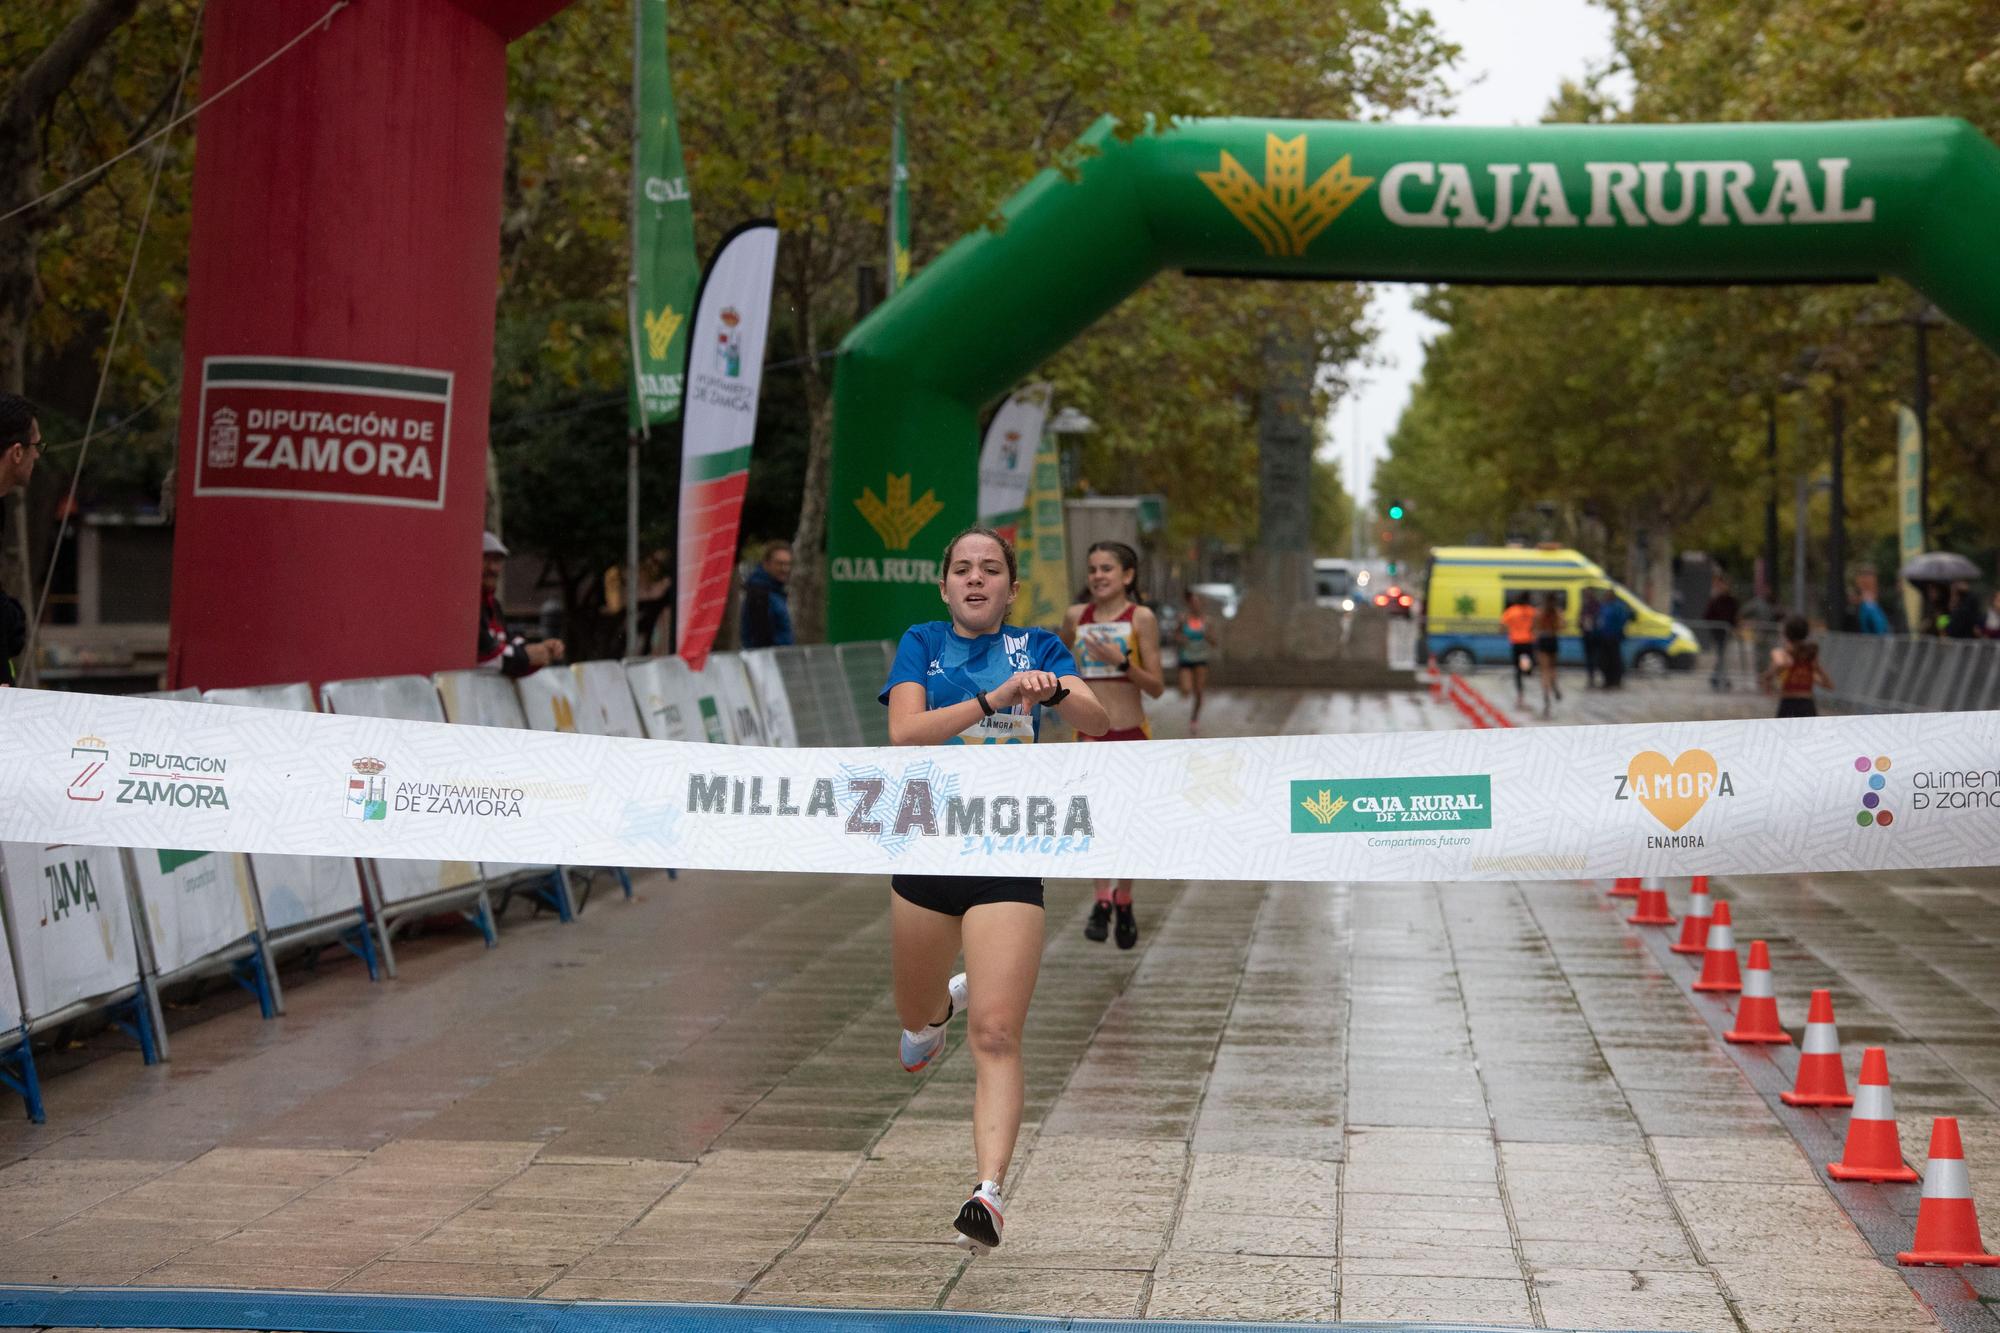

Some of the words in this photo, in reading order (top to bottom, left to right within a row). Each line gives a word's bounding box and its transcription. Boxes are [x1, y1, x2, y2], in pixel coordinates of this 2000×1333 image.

[1379, 160, 1579, 232] CAJA
[1585, 157, 1876, 227] RURAL
[247, 409, 398, 438] DIPUTACIÓN
[403, 419, 435, 442] DE
[243, 434, 433, 481] ZAMORA
[882, 557, 944, 585] RUR
[978, 716, 1014, 731] ZAMORA
[1613, 771, 1735, 801] ZAMORA
[1912, 770, 2000, 789] alimen
[116, 779, 230, 810] ZAMORA
[396, 781, 524, 802] AYUNTAMIENTO
[394, 795, 422, 813] DE
[427, 796, 522, 818] ZAMORA
[1352, 796, 1405, 813] CAJA
[1410, 793, 1484, 812] RURAL
[1376, 811, 1396, 823] DE
[1401, 810, 1461, 822] ZAMORA
[1367, 836, 1437, 849] Compartimos
[1437, 834, 1471, 849] futuro
[1647, 835, 1705, 849] ENAMORA
